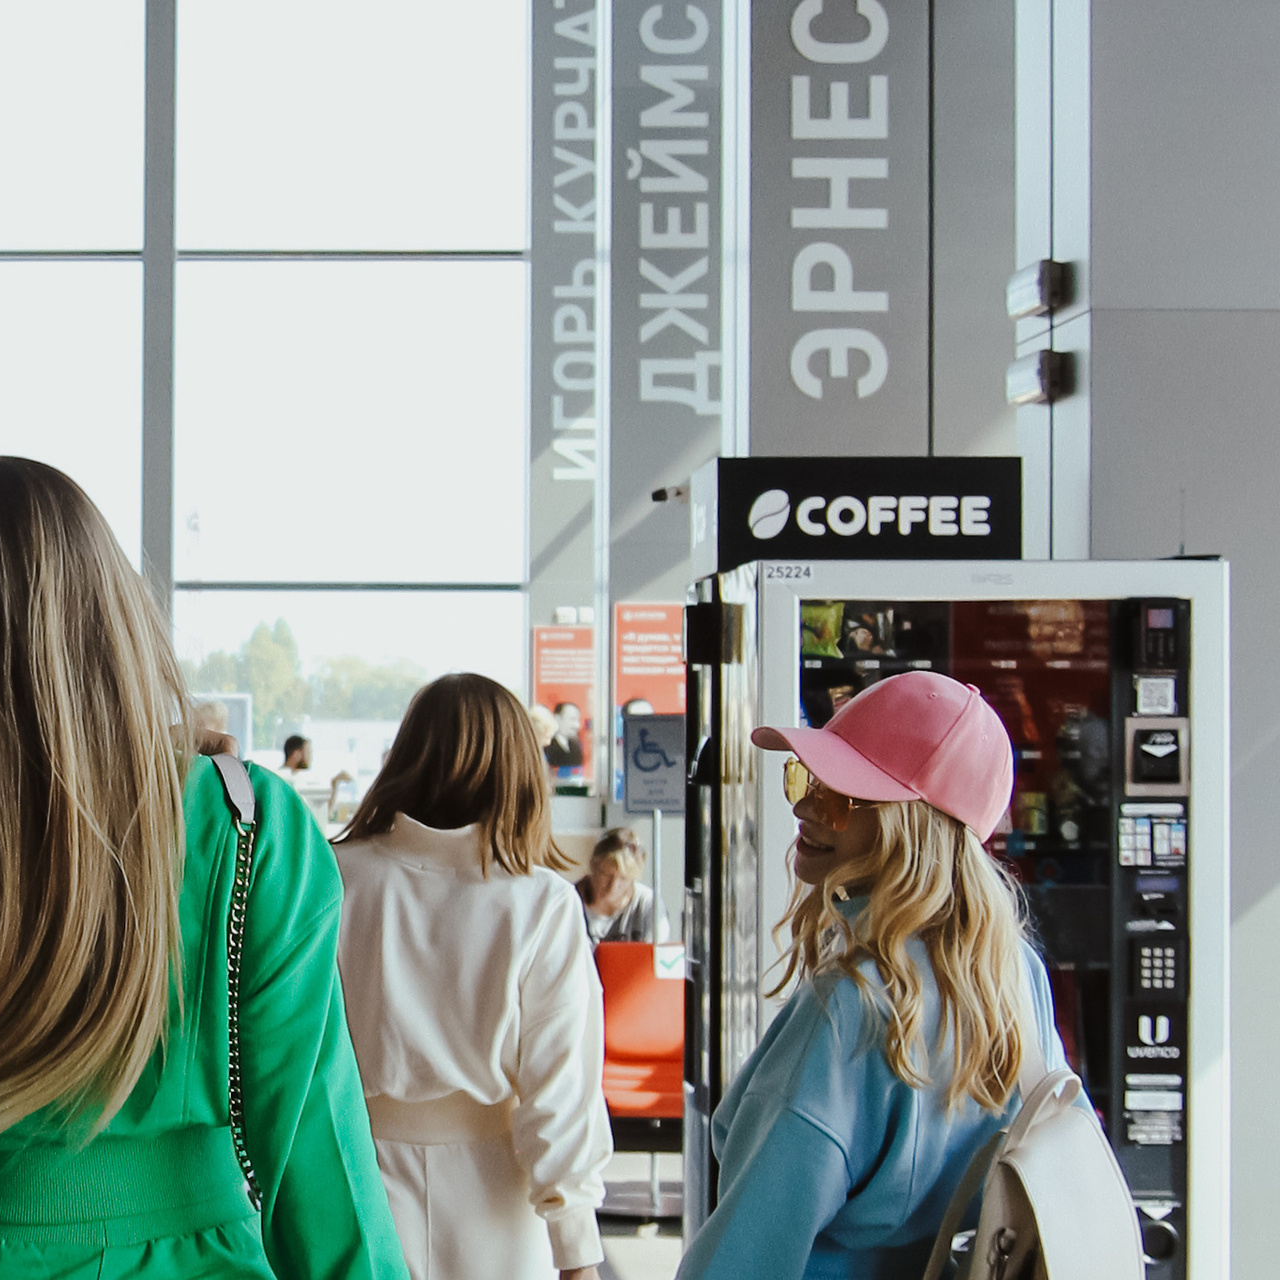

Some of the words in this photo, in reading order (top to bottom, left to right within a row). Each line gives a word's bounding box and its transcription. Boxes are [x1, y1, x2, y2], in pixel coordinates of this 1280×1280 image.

[626, 2, 723, 416] ДЖЕЙМС
[552, 258, 597, 481] ИГОРЬ
[766, 566, 812, 579] 25224
[795, 495, 992, 537] COFFEE
